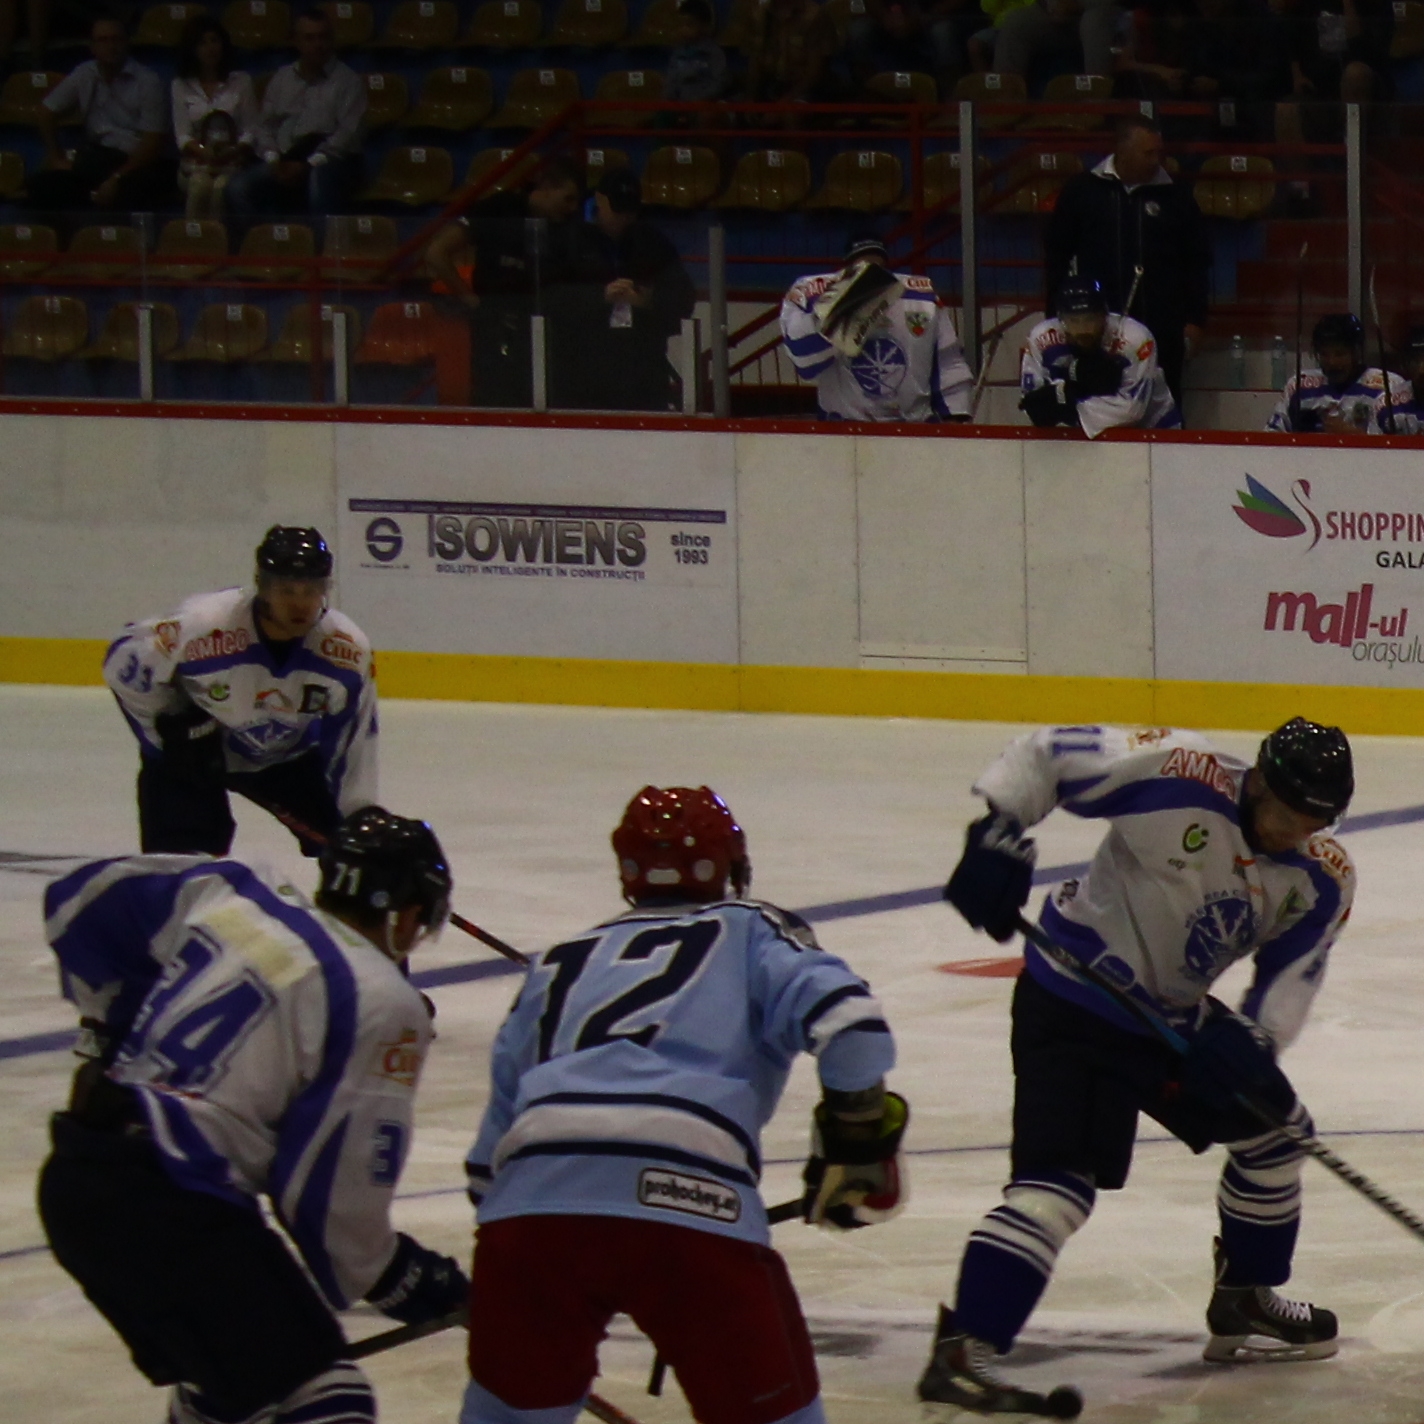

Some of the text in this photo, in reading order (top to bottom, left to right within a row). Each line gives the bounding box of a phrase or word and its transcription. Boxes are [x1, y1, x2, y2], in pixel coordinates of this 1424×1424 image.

[434, 515, 646, 568] SOWIENS
[670, 530, 712, 548] since
[673, 548, 709, 565] 1993
[1263, 583, 1408, 648] mall-ul
[537, 918, 724, 1064] 12
